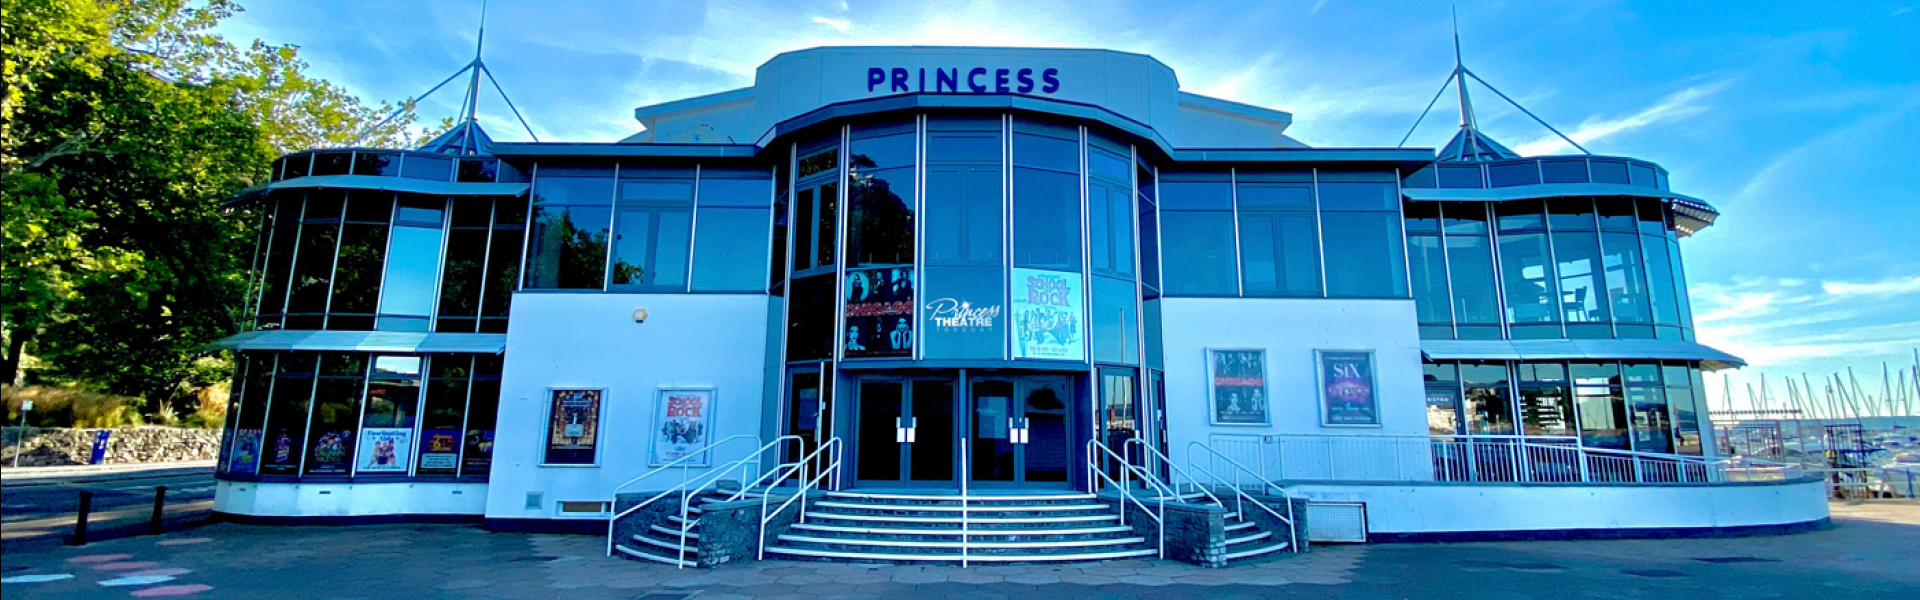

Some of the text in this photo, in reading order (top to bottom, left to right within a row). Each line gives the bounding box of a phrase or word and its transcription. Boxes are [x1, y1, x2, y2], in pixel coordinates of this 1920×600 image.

[868, 67, 1060, 93] PRINCESS
[1028, 289, 1071, 306] ROCK
[846, 301, 914, 317] CHICAGO
[925, 297, 1000, 321] Princess
[934, 316, 993, 327] THEATRE
[667, 405, 702, 417] ROCK
